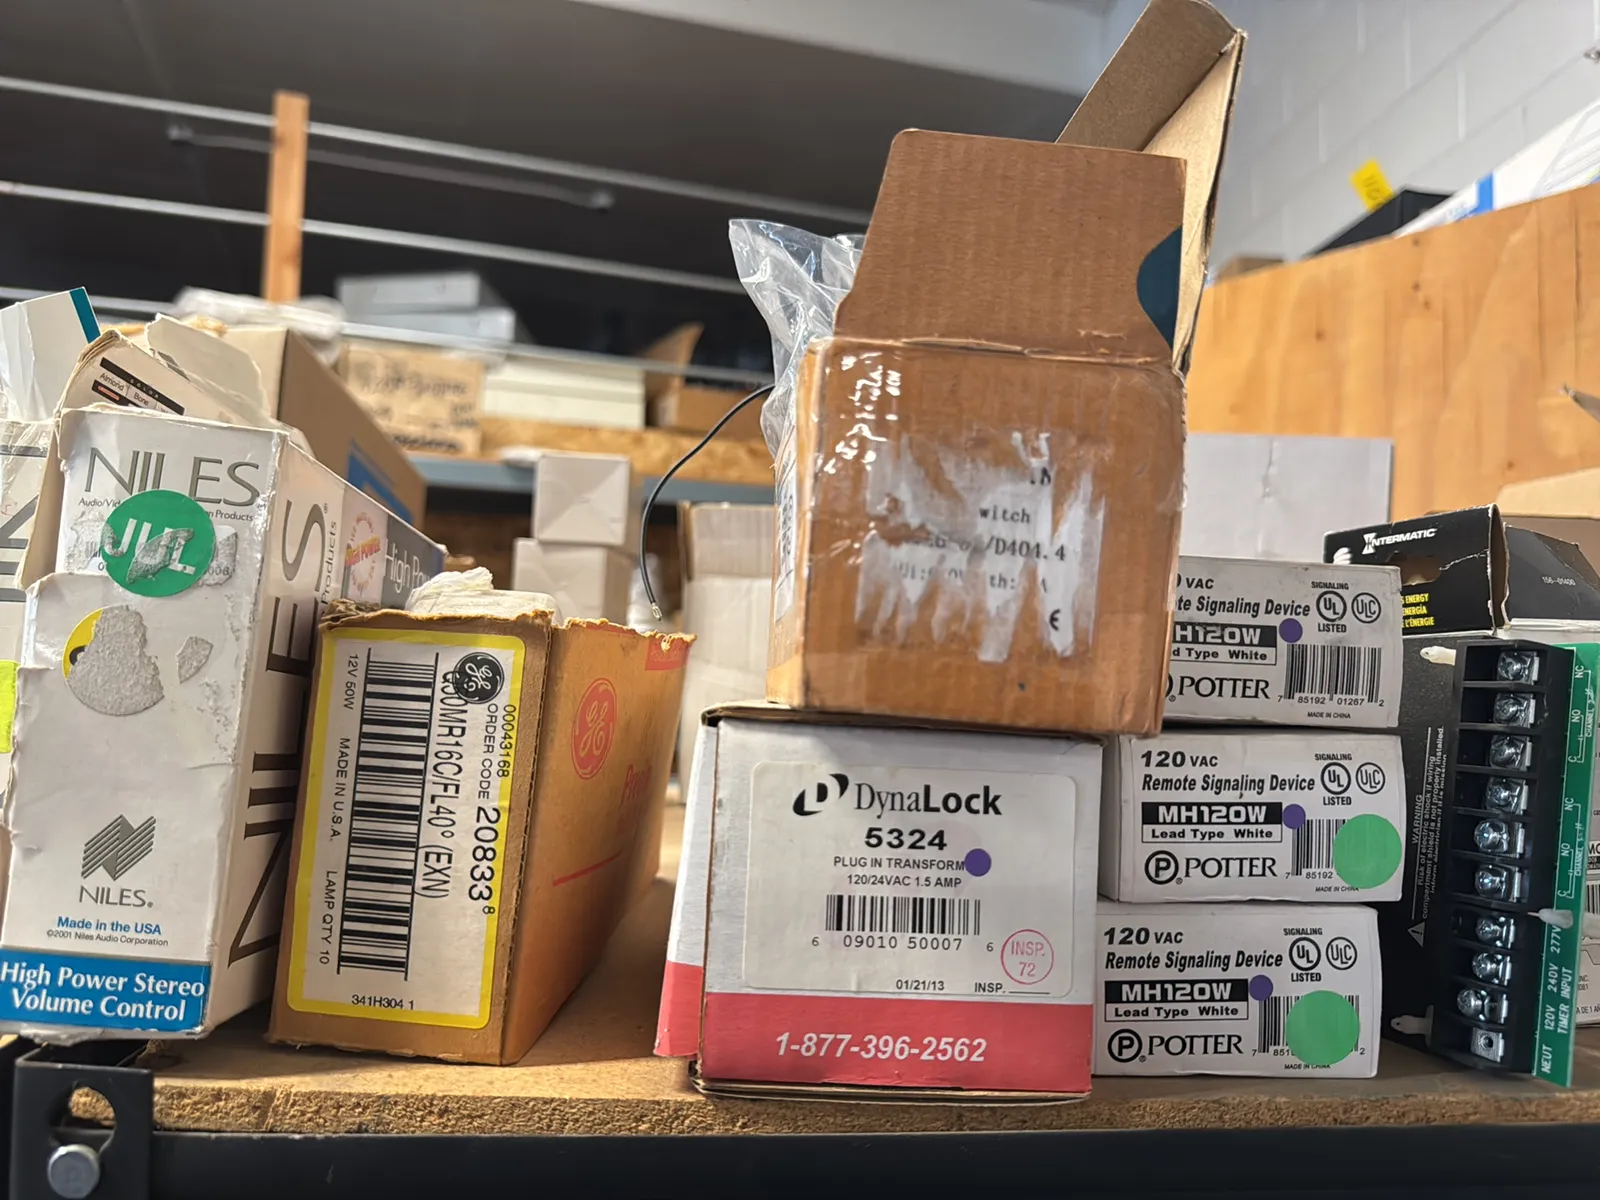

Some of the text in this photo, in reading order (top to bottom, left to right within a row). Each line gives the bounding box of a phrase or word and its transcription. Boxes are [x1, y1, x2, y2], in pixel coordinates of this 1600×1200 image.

[100, 372, 125, 392] Almond
[133, 391, 149, 406] Bone
[78, 497, 121, 507] Audio/Vid
[215, 509, 254, 522] Products
[1361, 528, 1438, 554] INTERMATIC
[320, 521, 337, 605] Products
[385, 543, 411, 593] High
[1186, 578, 1215, 590] VAC
[1311, 581, 1350, 590] SIGNALING
[1196, 595, 1261, 617] Signaling
[1264, 599, 1311, 617] Device
[1405, 593, 1429, 604] ENERGY
[1318, 622, 1348, 634] LISTED
[1186, 649, 1219, 661] Type
[1228, 649, 1268, 662] White
[1575, 665, 1584, 678] NC
[1179, 676, 1271, 700] POTTER
[1277, 695, 1385, 707] 7 85192 01267 2
[1572, 709, 1581, 723] NO
[1585, 707, 1595, 737] CHANNEL
[482, 703, 498, 754] ORDER
[329, 653, 358, 842] 12V 50W MADE IN U.S.A.
[496, 704, 516, 778] 00043168
[1434, 726, 1444, 765] installed.
[1141, 750, 1218, 767] 120 VAC
[1314, 753, 1353, 761] SIGNALING
[478, 758, 493, 800] CODE
[1426, 756, 1436, 783] wiring
[1142, 774, 1315, 795] Remote Signaling Device
[1431, 767, 1442, 803] properly
[854, 782, 1003, 819] DynaLock
[1322, 795, 1352, 806] LISTED
[1422, 793, 1431, 819] shock
[1564, 797, 1574, 811] NC
[1158, 805, 1268, 823] MH120W
[1411, 795, 1423, 844] WARNING
[1429, 805, 1437, 820] not
[1151, 828, 1273, 841] Lead Type White
[1428, 822, 1435, 830] is
[864, 827, 948, 851] 5324
[1420, 821, 1429, 853] electric
[1425, 832, 1435, 858] shield
[468, 806, 501, 902] 20833
[1418, 854, 1426, 864] of
[1561, 843, 1570, 856] NO
[833, 856, 868, 868] PLUG
[870, 857, 883, 868] IN
[1184, 857, 1278, 878] POTTER
[1574, 846, 1584, 877] CHANNEL
[414, 844, 454, 899] (EXN)
[847, 874, 962, 888] 120/24VAC 1.5 AMP
[1285, 871, 1333, 880] 7 85192
[1417, 866, 1425, 885] Risk
[1421, 861, 1432, 919] compartment
[57, 916, 162, 936] Made in the USA
[319, 870, 338, 965] LAMP QTY 10
[47, 929, 169, 947] ©2001 Niles Audio Corporation
[1104, 927, 1184, 945] 120 VAC
[1283, 928, 1323, 936] SIGNALING
[811, 935, 994, 953] 6 09010 50007 6
[1010, 941, 1046, 957] INSP.
[1018, 961, 1037, 977] 72
[1105, 950, 1283, 973] Remote Signaling Device
[0, 961, 206, 997] High Power Stereo
[895, 979, 945, 991] 01/21/13
[1291, 973, 1322, 982] LISTED
[351, 995, 404, 1009] 341H304
[1121, 983, 1232, 1002] MH120W
[1541, 926, 1562, 1073] NEUT 120V 240V 277V
[1557, 967, 1573, 1035] TIMER INPUT
[11, 988, 186, 1021] Volume Control
[1114, 1006, 1238, 1019] Lead Type White
[775, 1031, 988, 1062] 1-877-396-2562
[1148, 1034, 1244, 1056] POTTER
[1360, 1047, 1365, 1055] 2
